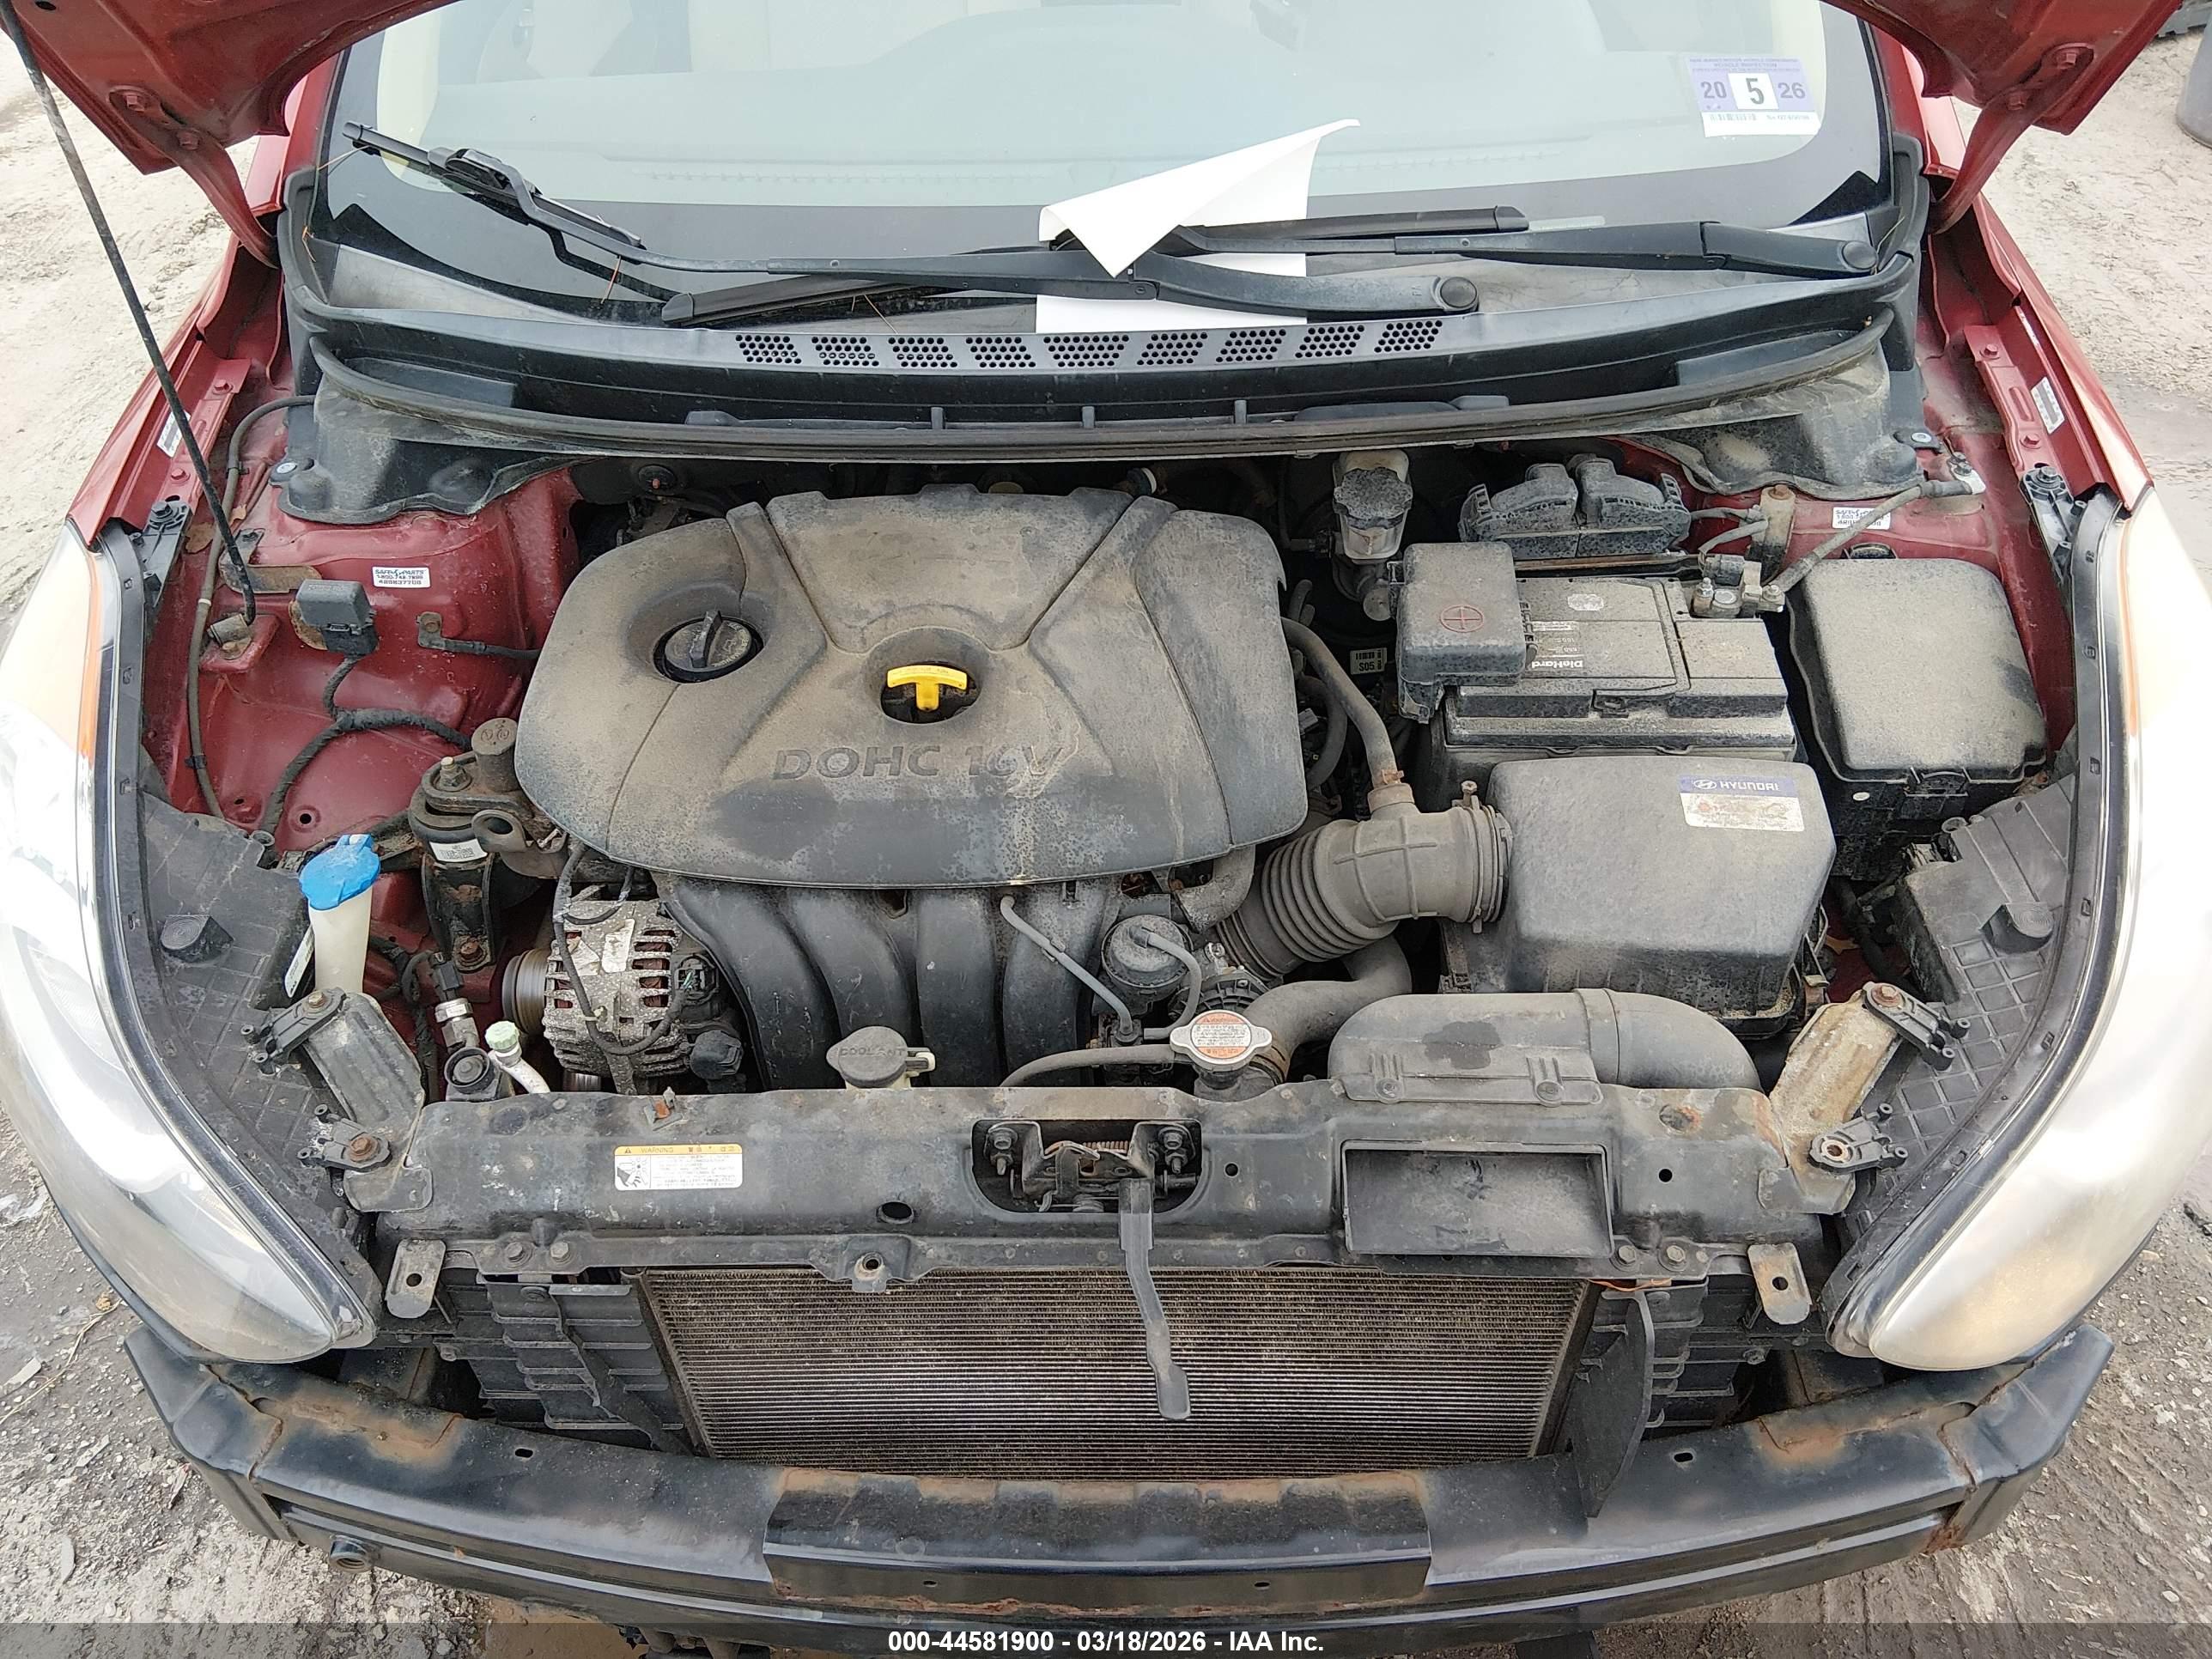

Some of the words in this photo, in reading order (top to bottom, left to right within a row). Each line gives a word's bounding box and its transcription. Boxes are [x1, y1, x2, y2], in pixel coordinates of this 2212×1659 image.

[1701, 82, 1727, 99] 20
[1746, 78, 1765, 105] 5
[1778, 82, 1806, 99] 26
[1358, 661, 1375, 672] S05
[773, 744, 940, 780] DOHC
[965, 744, 1063, 776] 16V
[1720, 781, 1780, 791] HYUNDAI
[840, 1047, 905, 1058] COOLANT
